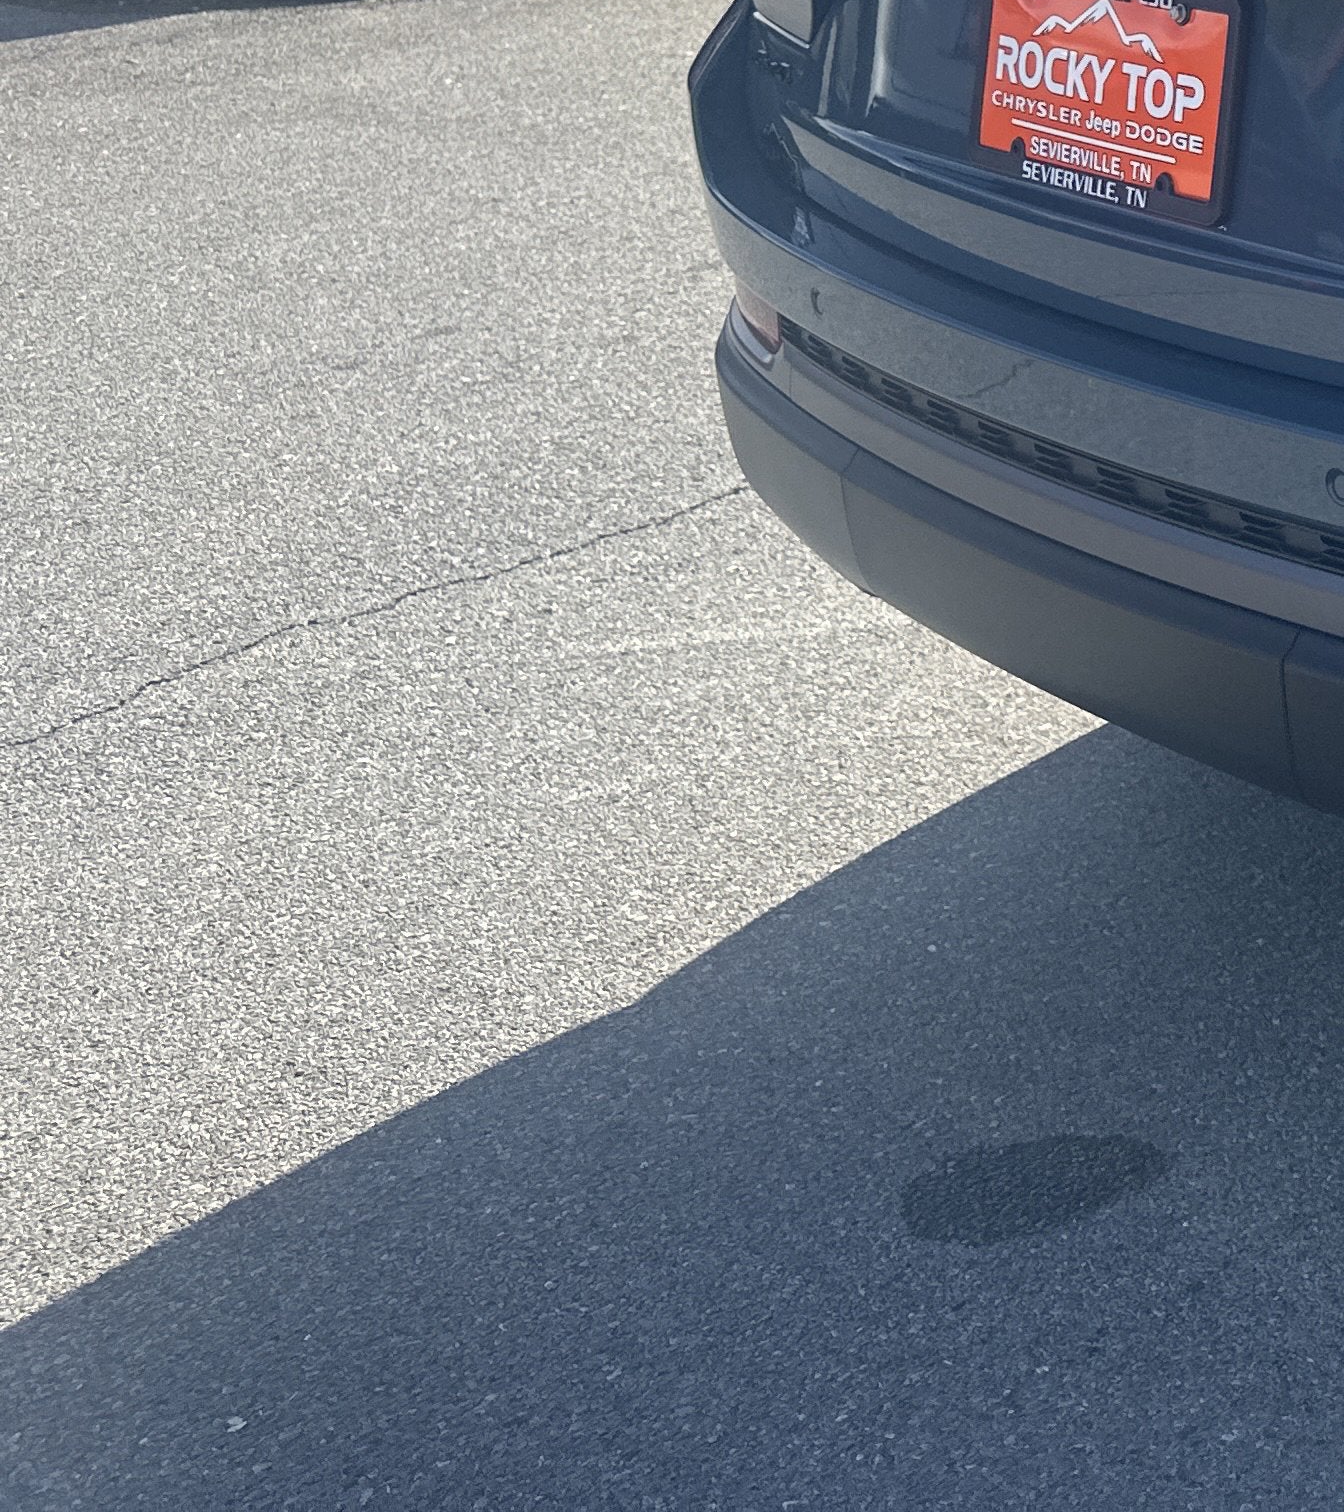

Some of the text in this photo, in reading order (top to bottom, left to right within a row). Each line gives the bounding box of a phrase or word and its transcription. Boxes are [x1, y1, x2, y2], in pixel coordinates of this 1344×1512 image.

[995, 35, 1206, 122] ROCKY TOP
[991, 90, 1204, 154] CHRYSLER Jeep DODGE
[1022, 160, 1147, 208] SEVIERVILLE, TN
[1030, 135, 1152, 183] SEVIERVILLE, TN
